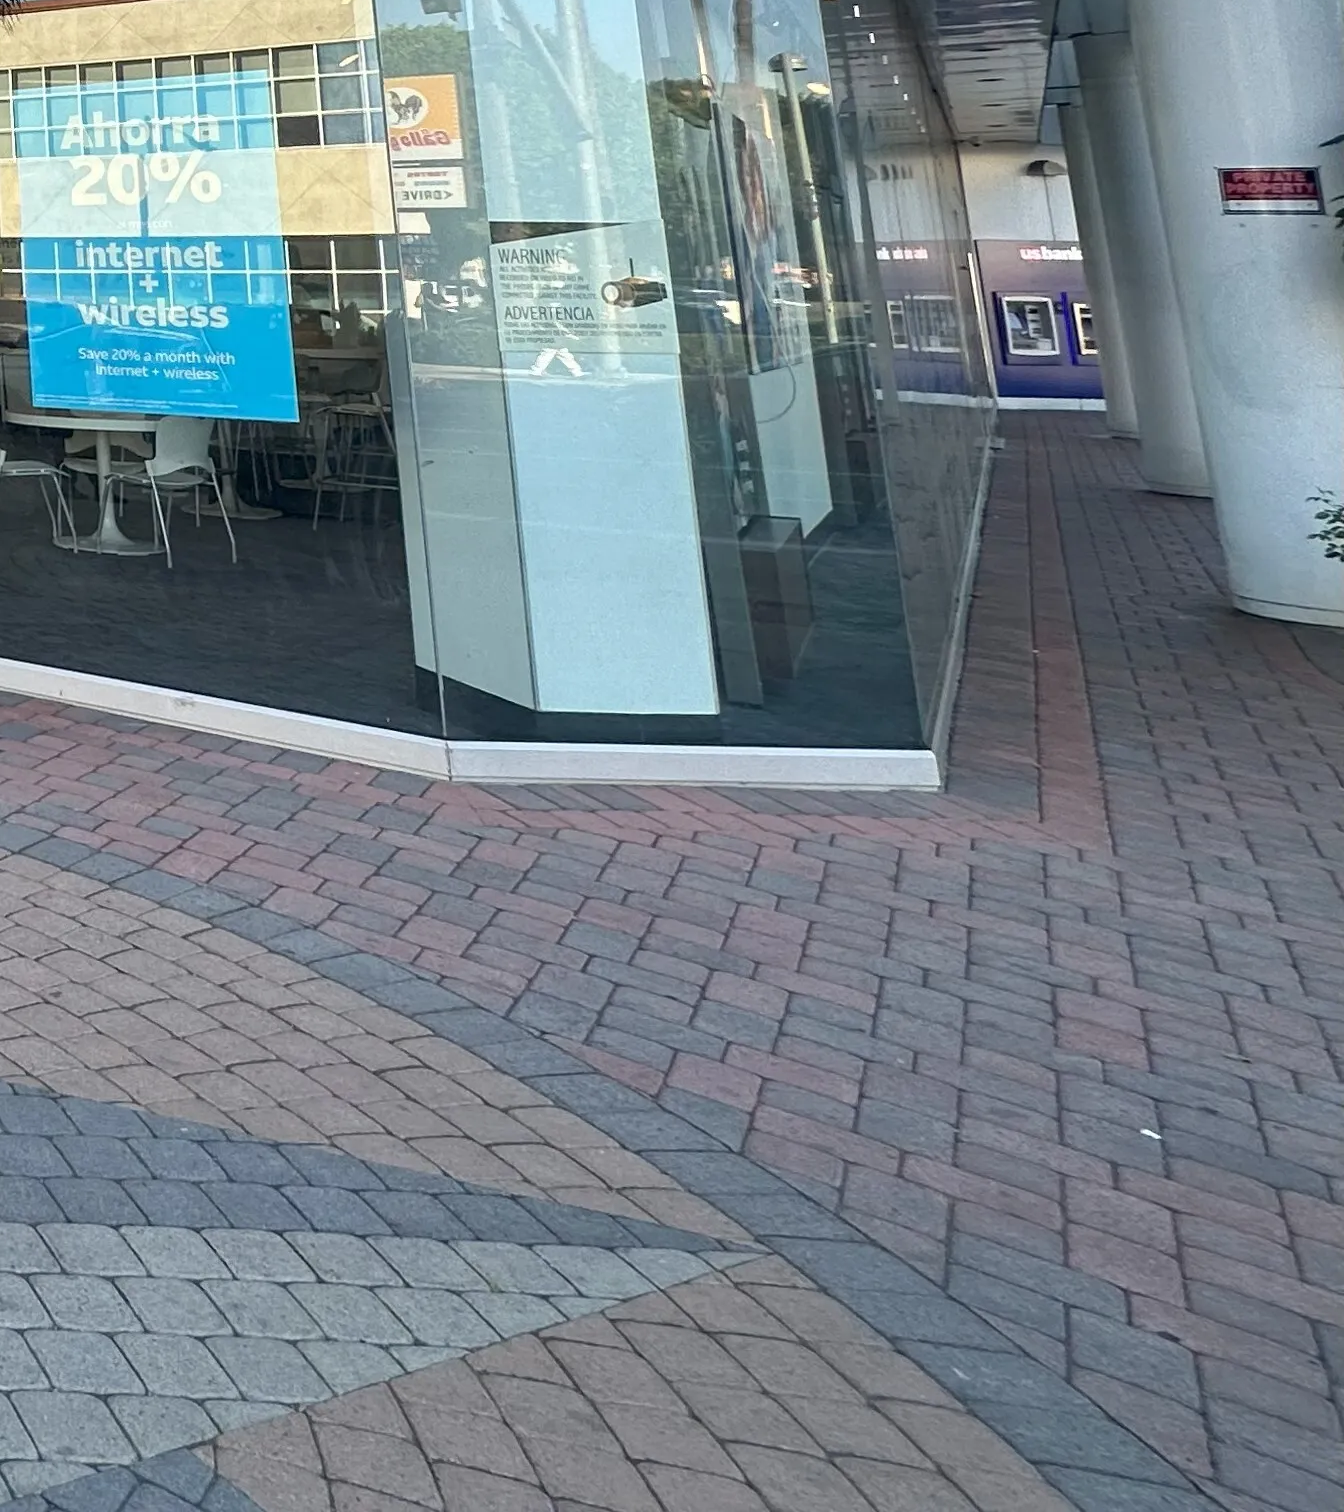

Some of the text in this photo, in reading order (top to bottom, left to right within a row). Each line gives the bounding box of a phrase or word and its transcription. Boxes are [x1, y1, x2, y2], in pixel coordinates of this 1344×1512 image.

[60, 111, 220, 149] Ahorra
[69, 150, 222, 206] 20%
[75, 240, 224, 268] internet
[139, 274, 159, 293] +
[77, 296, 230, 328] wireless
[504, 305, 595, 320] ADVERTENCIA
[78, 347, 236, 365] Save 20% a month with
[162, 367, 220, 381] wireless
